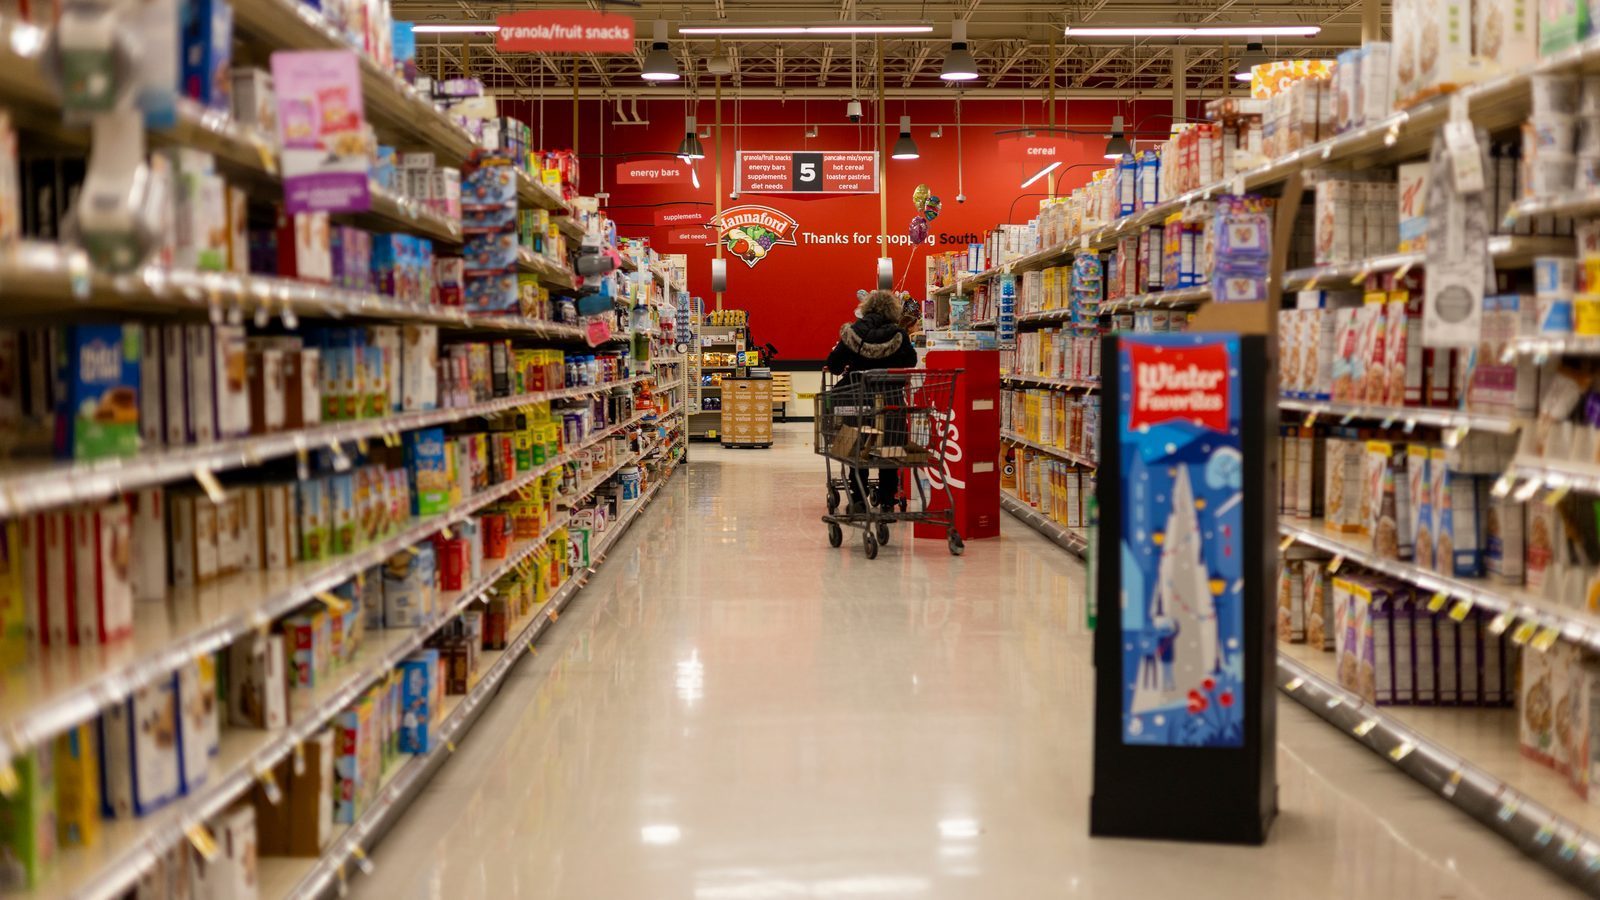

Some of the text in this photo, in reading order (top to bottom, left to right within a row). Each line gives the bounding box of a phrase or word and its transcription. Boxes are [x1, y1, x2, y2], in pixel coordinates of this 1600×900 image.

[501, 24, 629, 41] granola/fruit snacks
[1027, 147, 1056, 155] cereal
[847, 154, 873, 162] mix/syrup
[630, 168, 680, 178] energy bars
[800, 163, 816, 181] 5
[663, 213, 702, 221] supplements
[802, 232, 849, 244] Thanks
[853, 232, 872, 244] for
[939, 233, 978, 245] South
[1138, 363, 1223, 389] Winter
[1139, 392, 1223, 410] Favorites
